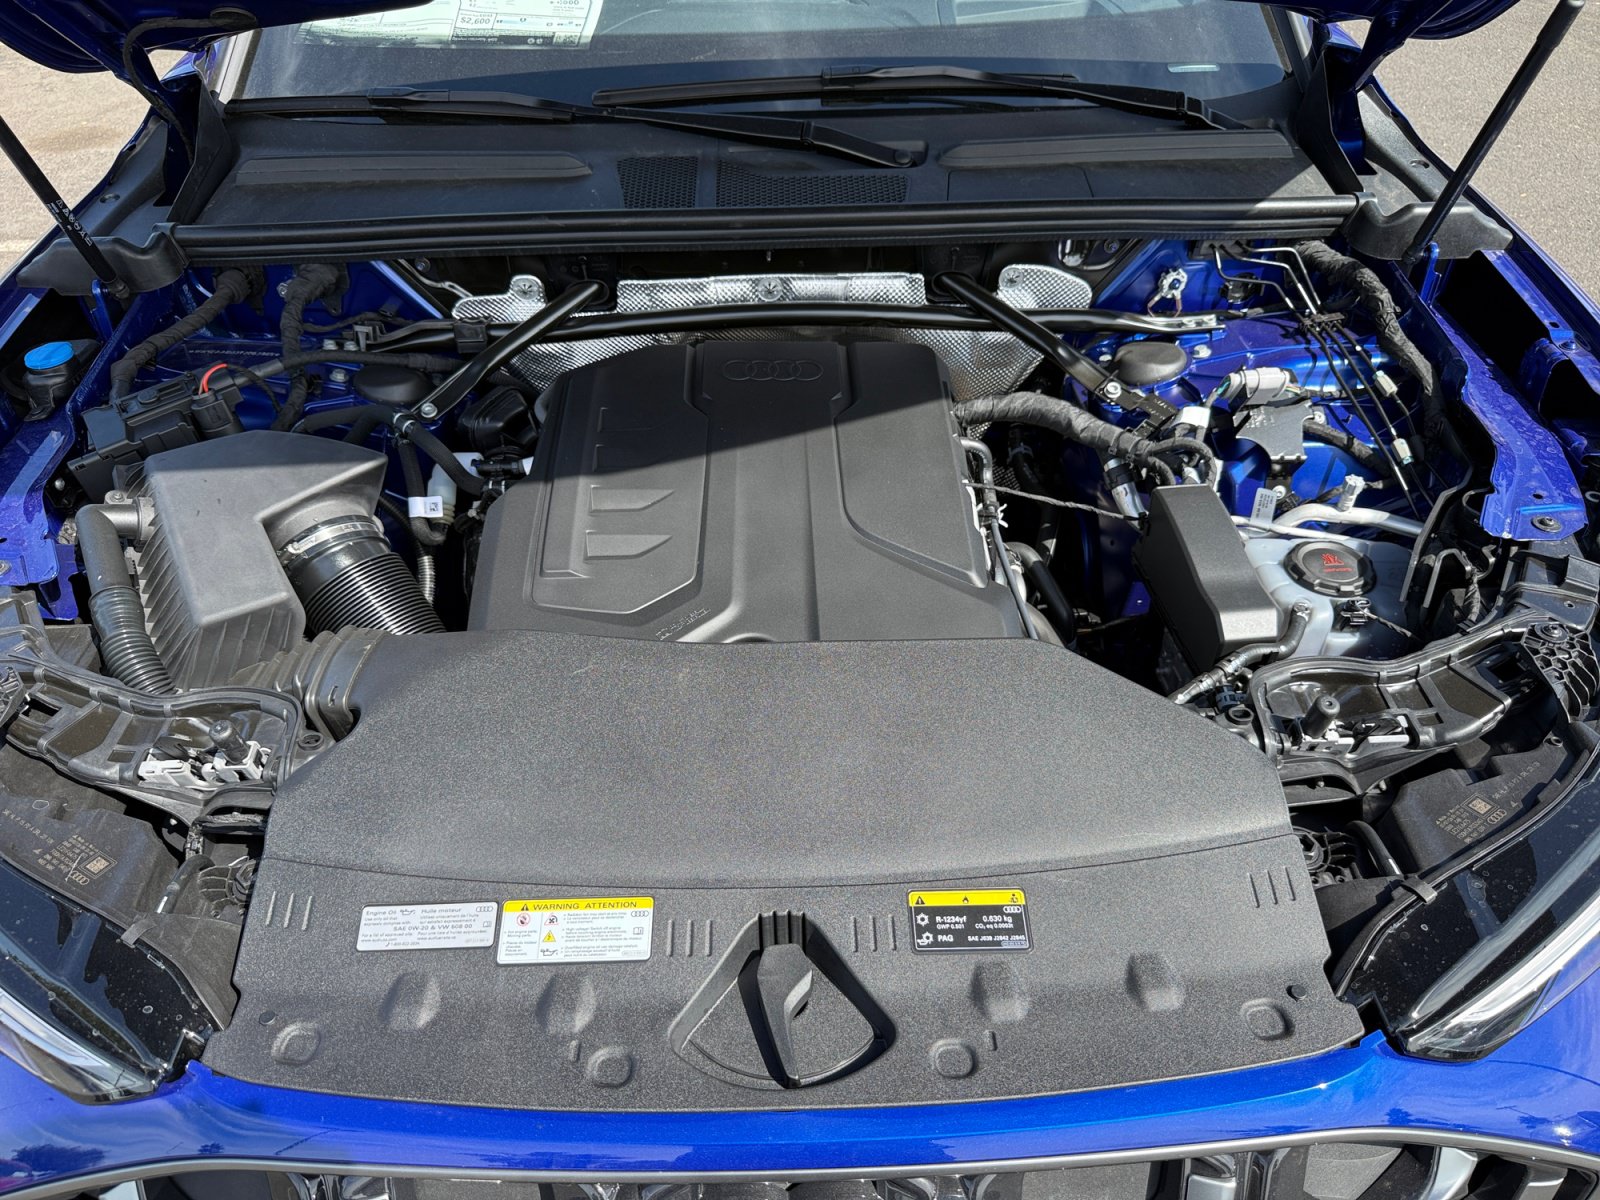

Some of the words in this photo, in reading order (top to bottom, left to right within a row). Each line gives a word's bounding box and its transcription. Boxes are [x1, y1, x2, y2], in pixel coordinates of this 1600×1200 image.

[460, 17, 491, 25] $2,600
[584, 901, 637, 909] ATTENTION
[935, 915, 967, 924] R-1234yf
[1003, 915, 1013, 923] kg
[937, 934, 954, 943] PAG
